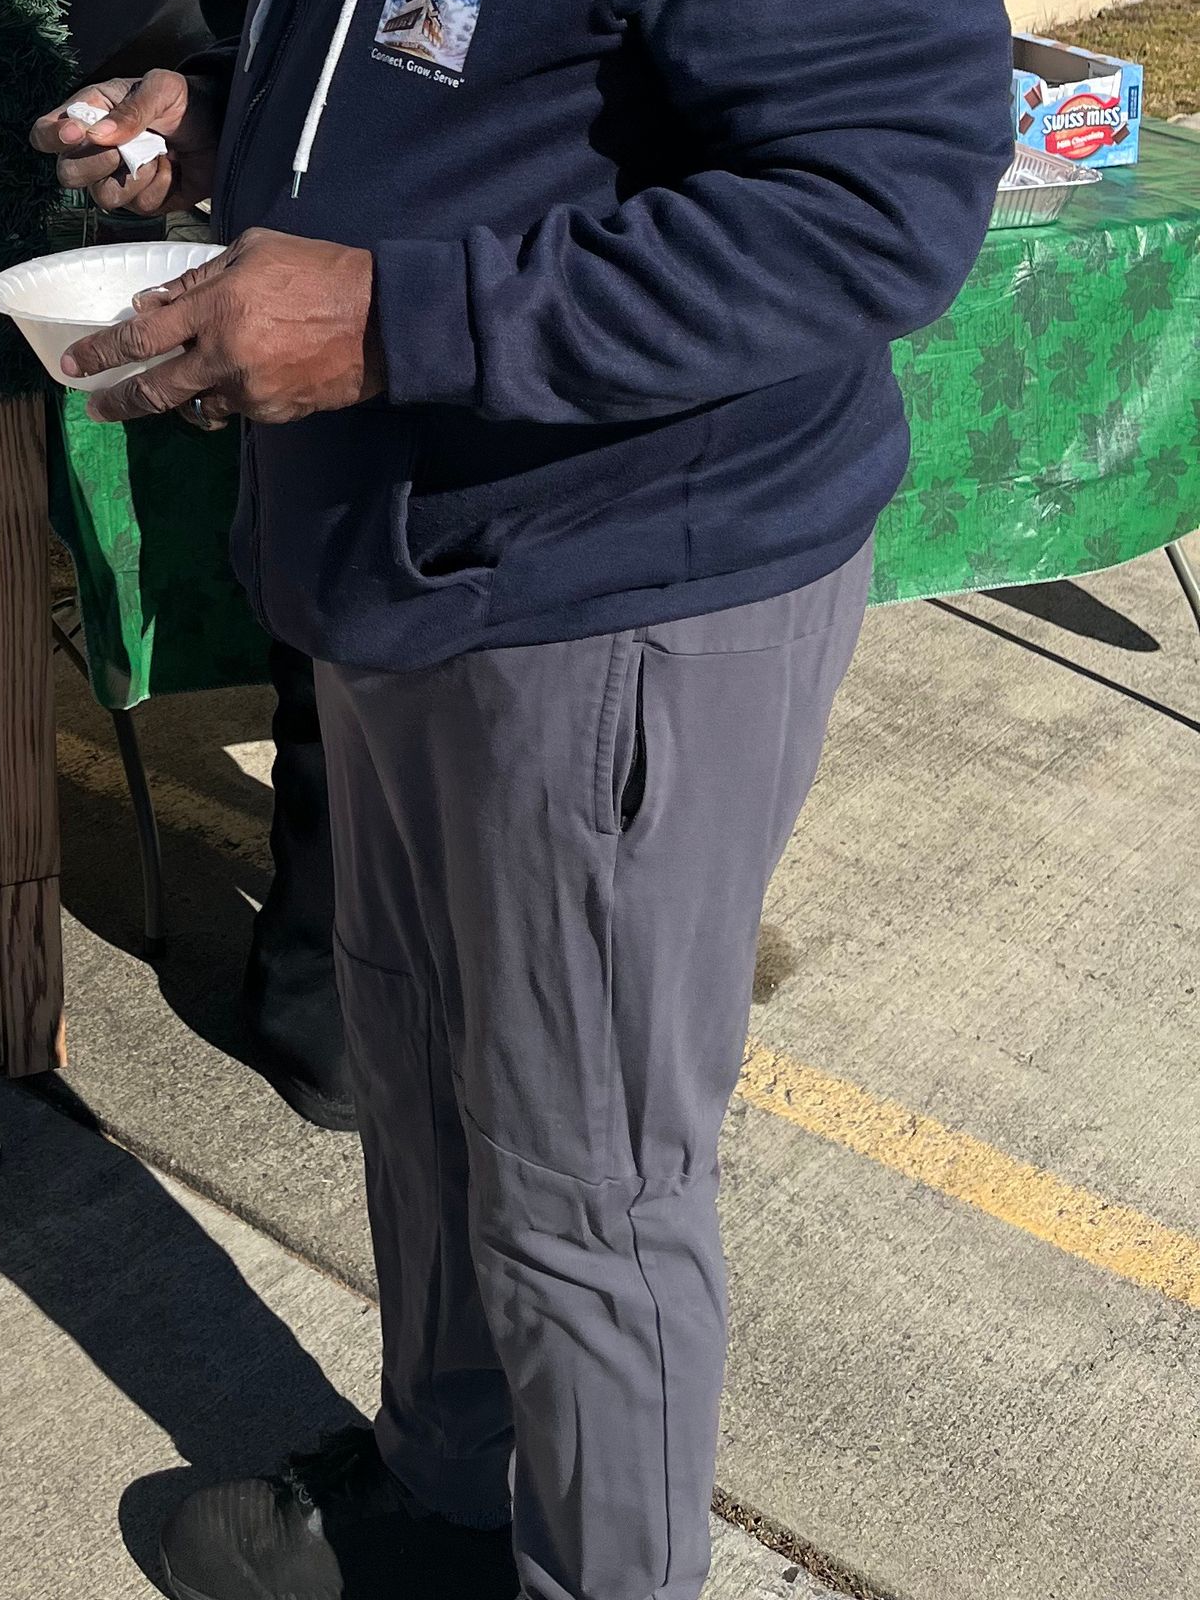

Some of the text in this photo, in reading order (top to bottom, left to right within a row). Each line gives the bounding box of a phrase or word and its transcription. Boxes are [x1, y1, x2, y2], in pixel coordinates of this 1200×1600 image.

[406, 60, 432, 79] Grow,
[1042, 106, 1121, 135] SWISS MISS
